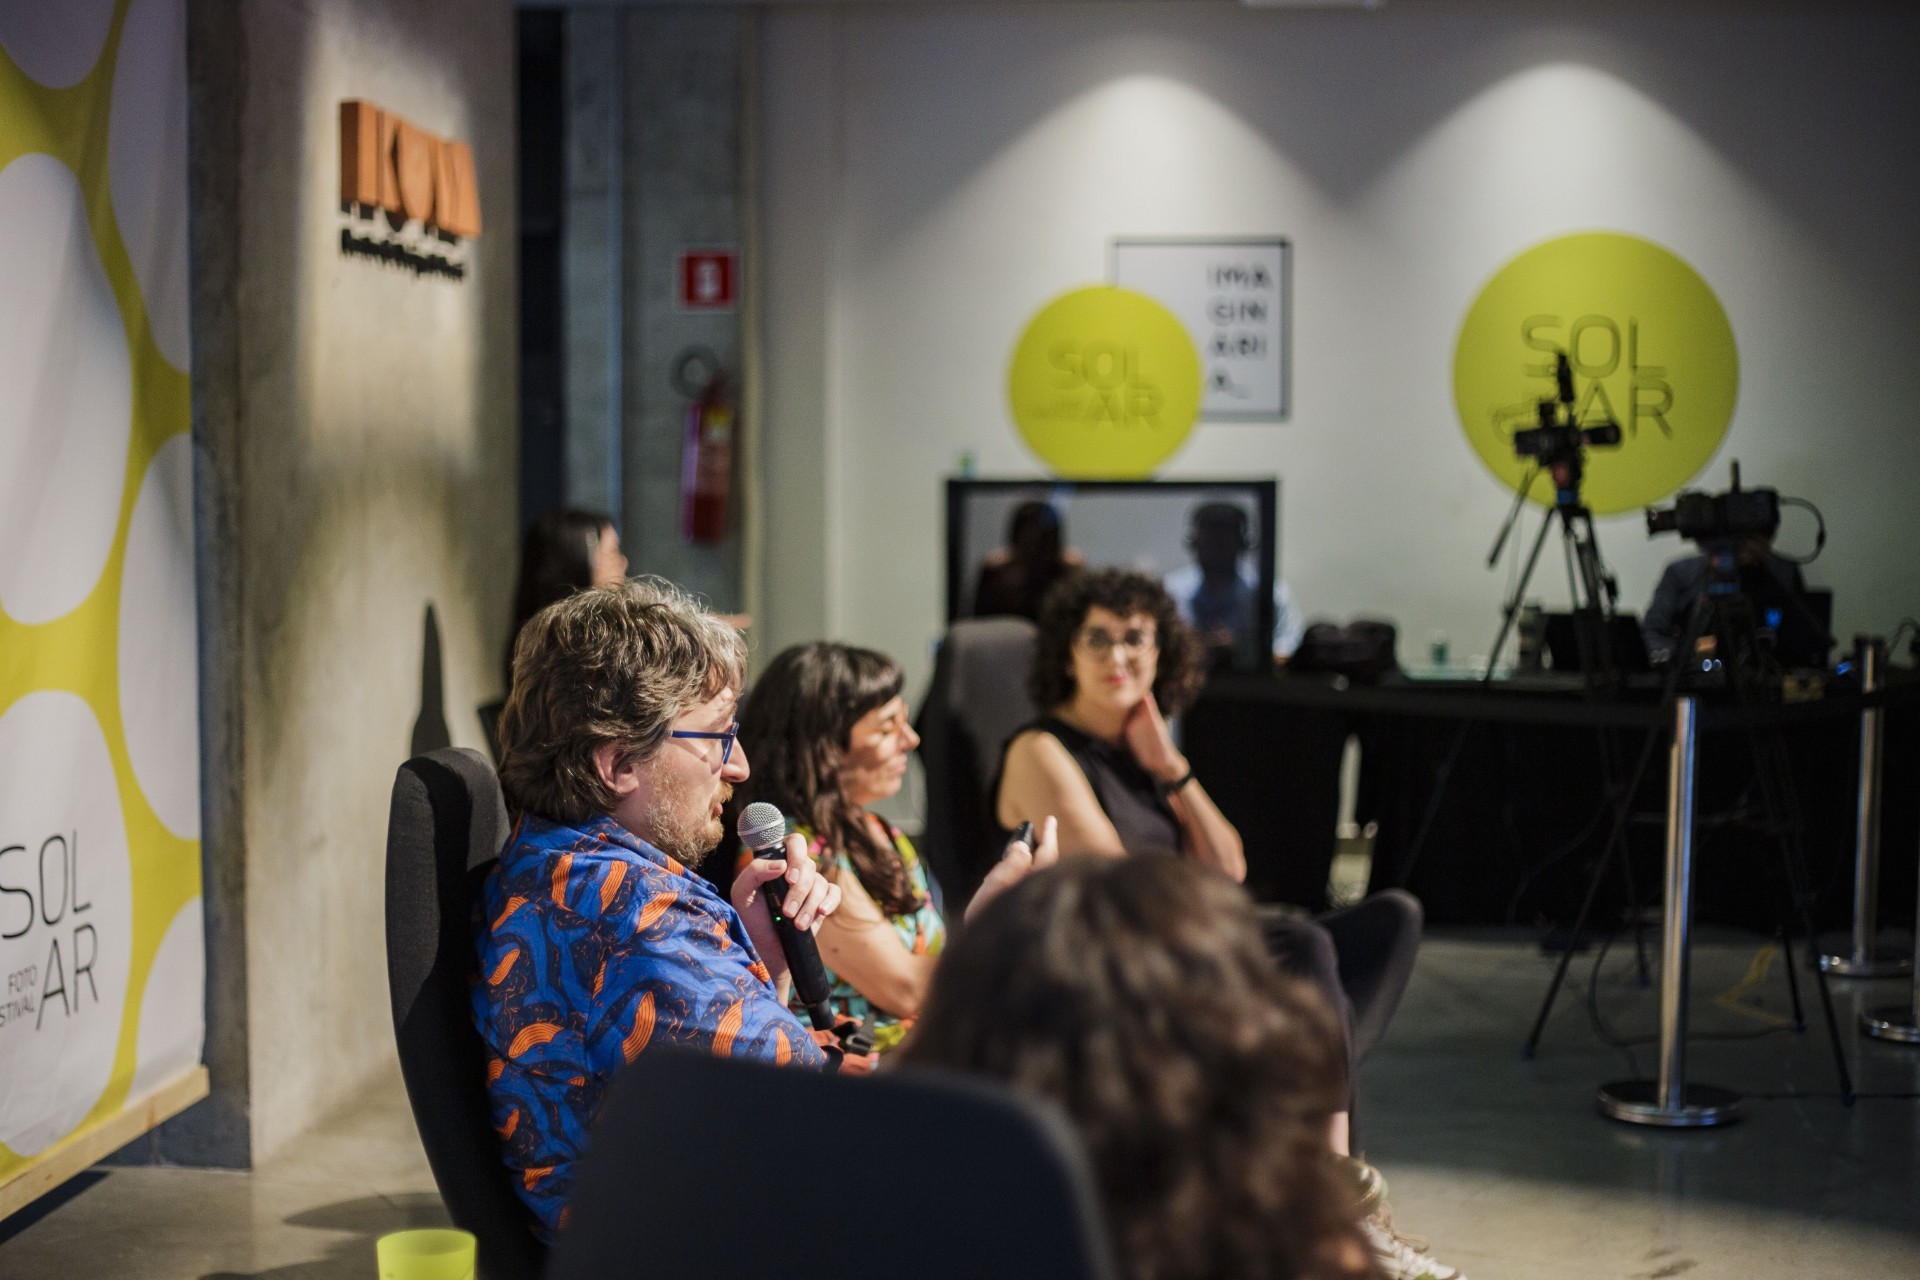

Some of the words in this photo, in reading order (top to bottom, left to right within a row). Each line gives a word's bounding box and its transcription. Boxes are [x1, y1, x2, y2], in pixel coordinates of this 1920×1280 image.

[1048, 340, 1157, 391] SOL
[1520, 313, 1669, 379] SOL
[1083, 388, 1166, 430] AR
[1572, 376, 1674, 440] AR
[0, 829, 92, 940] SOL
[8, 963, 38, 996] FOTO
[36, 924, 100, 1031] AR
